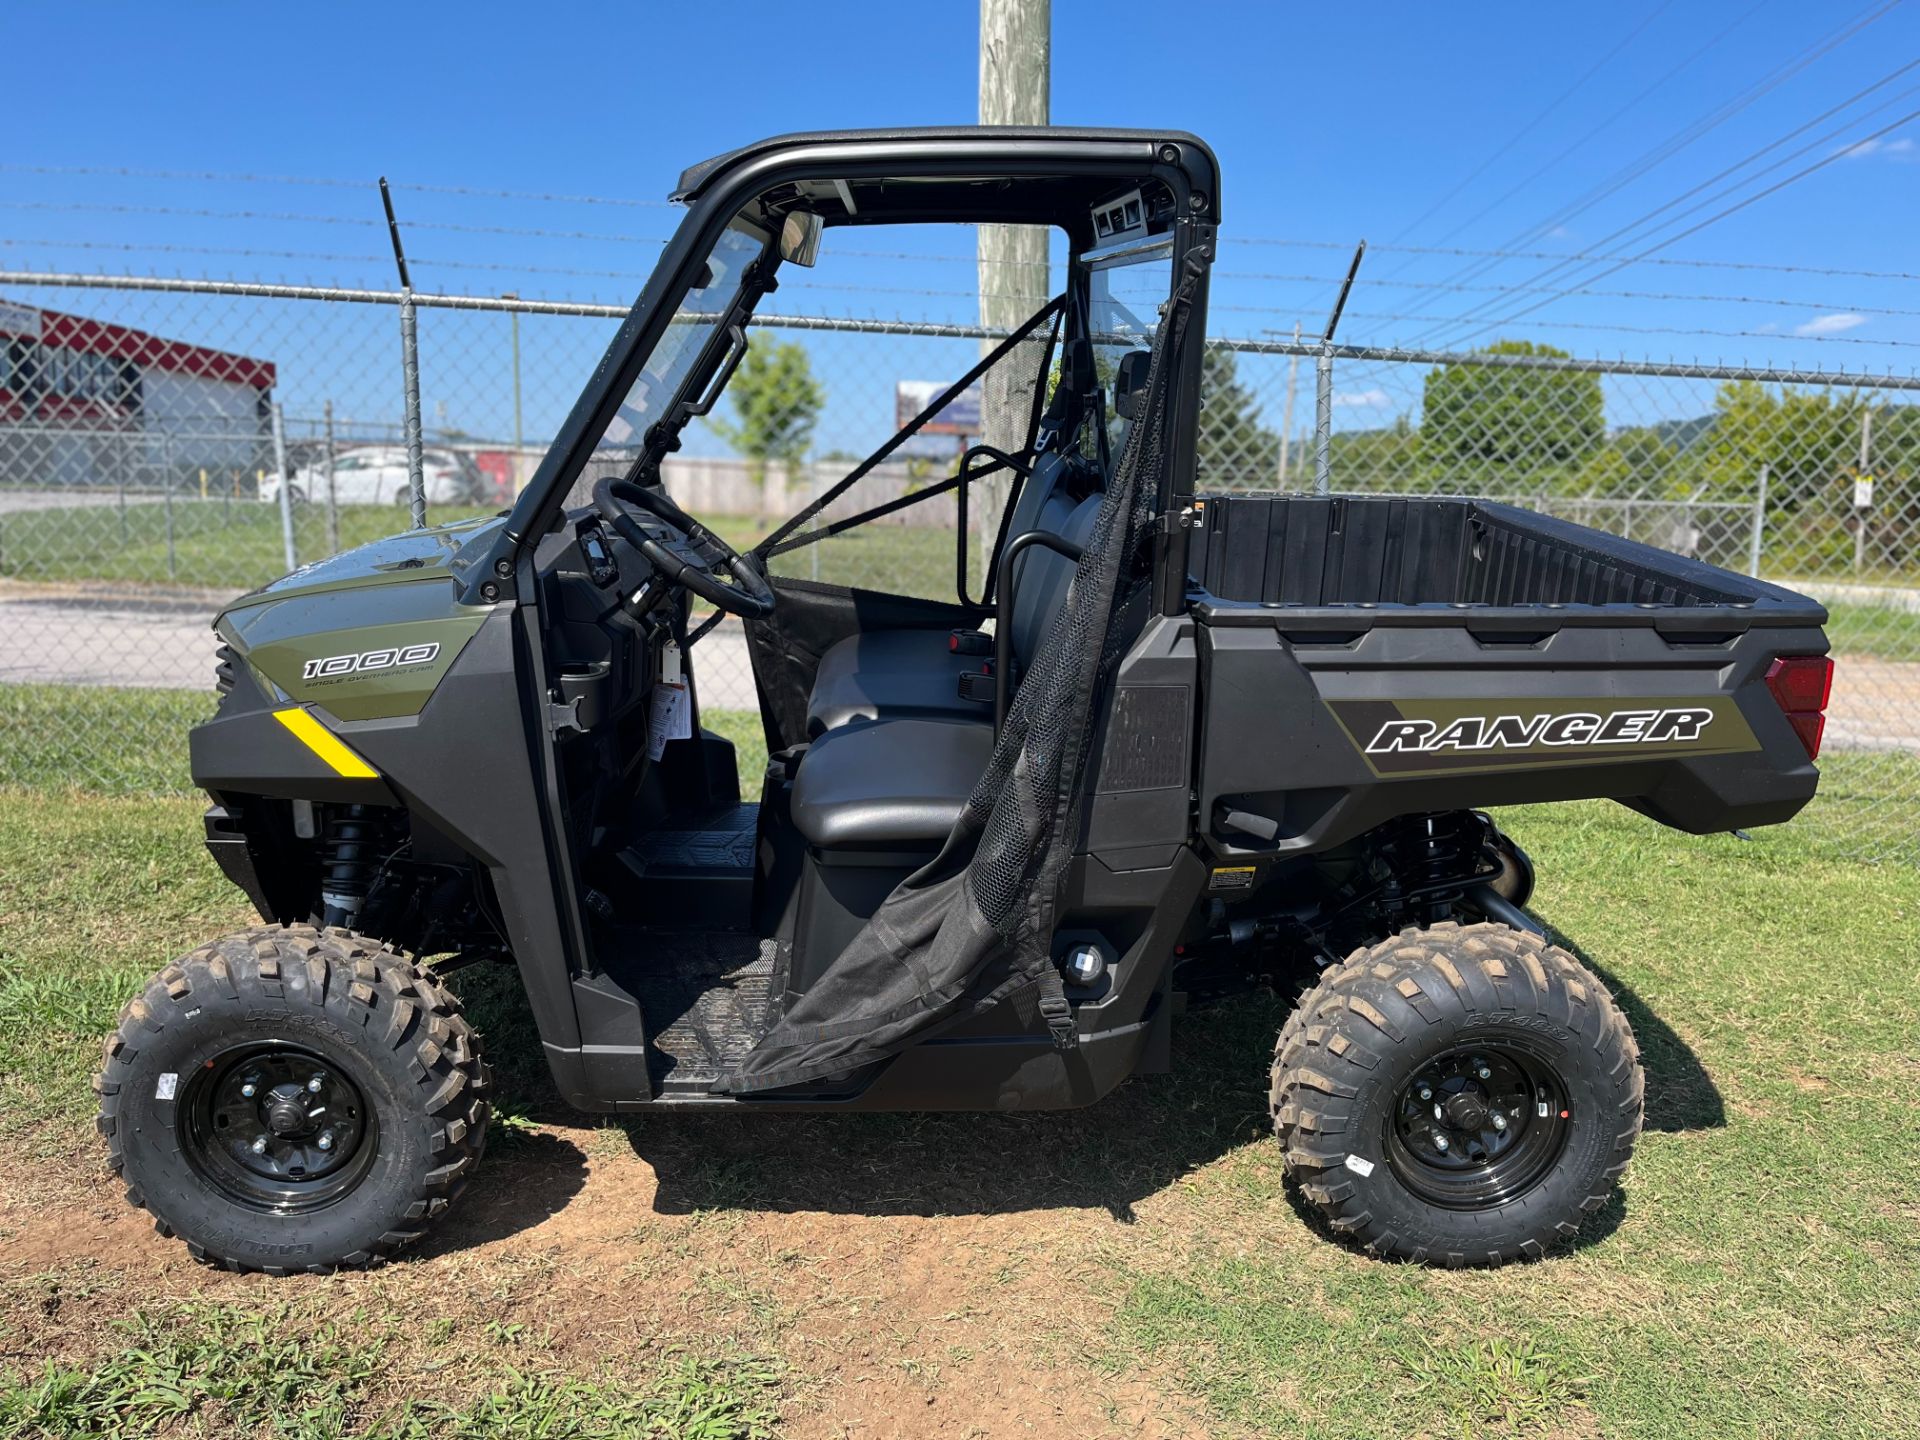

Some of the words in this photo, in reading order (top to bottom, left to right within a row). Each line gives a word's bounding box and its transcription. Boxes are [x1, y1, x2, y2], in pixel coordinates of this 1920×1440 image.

[303, 642, 441, 679] 1000
[305, 678, 344, 688] SINGLE
[348, 668, 406, 682] OVERHEAD
[409, 665, 433, 673] CAM
[1365, 708, 1713, 752] RANGER
